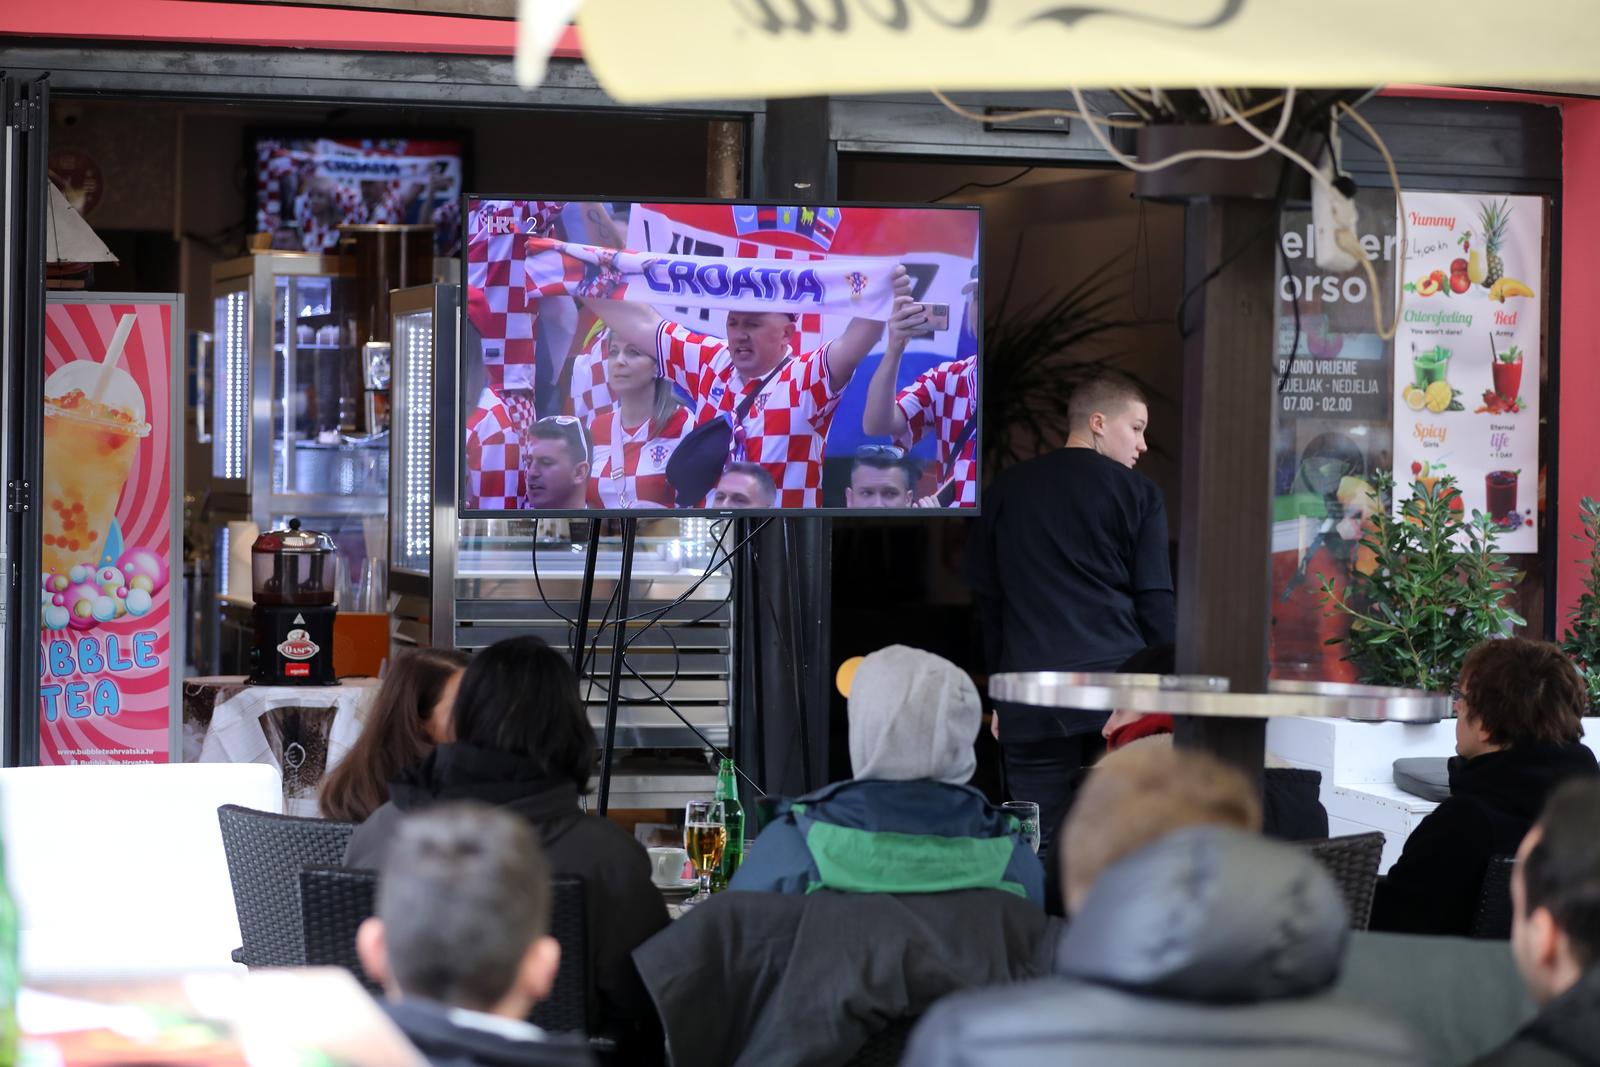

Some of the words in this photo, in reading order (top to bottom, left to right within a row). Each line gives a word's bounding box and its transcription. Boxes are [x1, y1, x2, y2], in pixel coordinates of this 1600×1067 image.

[526, 216, 537, 234] 2
[1409, 211, 1456, 231] Yummy
[641, 258, 826, 304] CROATIA
[1494, 310, 1518, 325] Red
[1316, 360, 1357, 375] VRIJEME
[1332, 380, 1379, 393] NEDJELJA
[1283, 397, 1313, 411] 07.00
[1322, 398, 1352, 412] 02.00
[1413, 423, 1447, 442] Spicy
[1490, 433, 1509, 451] life
[40, 679, 120, 722] TEA
[57, 748, 154, 756] www.bubbleteahrvatska.hr
